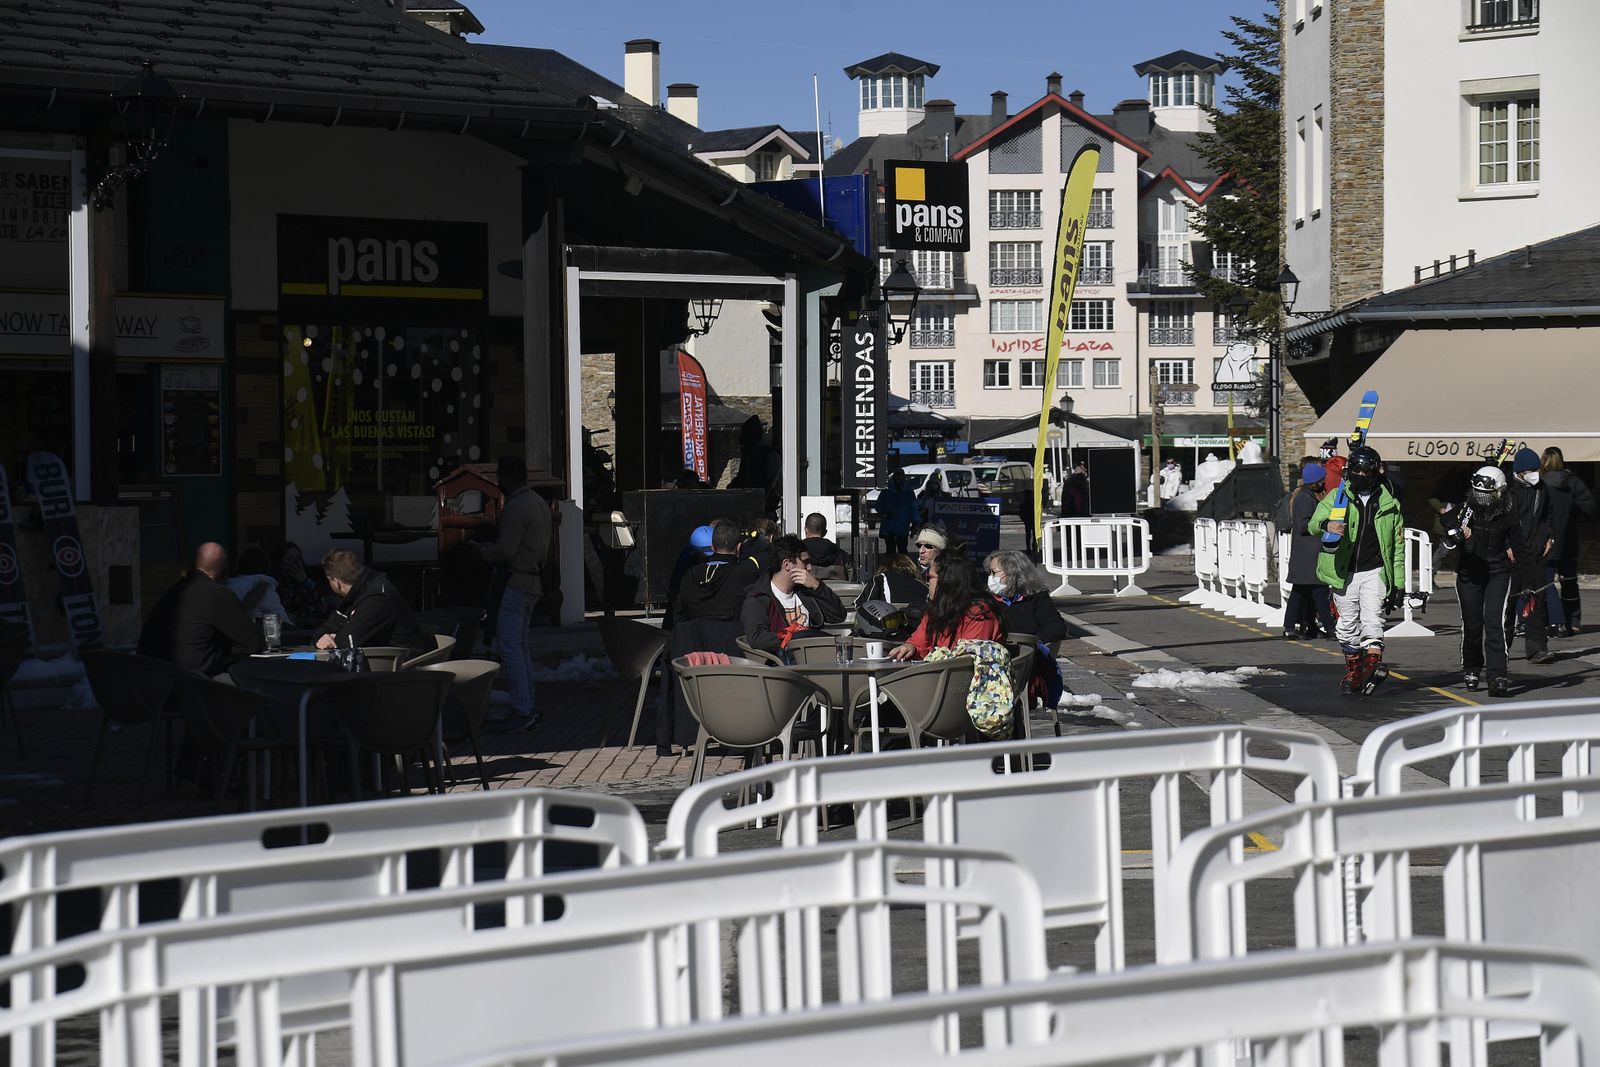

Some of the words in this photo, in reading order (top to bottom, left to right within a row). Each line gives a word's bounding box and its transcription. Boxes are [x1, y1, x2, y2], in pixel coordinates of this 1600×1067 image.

[895, 203, 963, 233] pans
[26, 226, 44, 239] LA
[915, 226, 921, 242] &
[924, 227, 963, 244] COMPANY
[327, 236, 440, 296] pans
[1056, 217, 1079, 332] pans
[115, 315, 158, 335] WAY
[991, 337, 1045, 353] INSIDE
[855, 331, 875, 478] MERIENDAS
[375, 410, 416, 423] GUSTAN
[331, 425, 351, 438] LAS
[353, 425, 395, 439] BUENAS
[397, 425, 436, 439] VISTAS!
